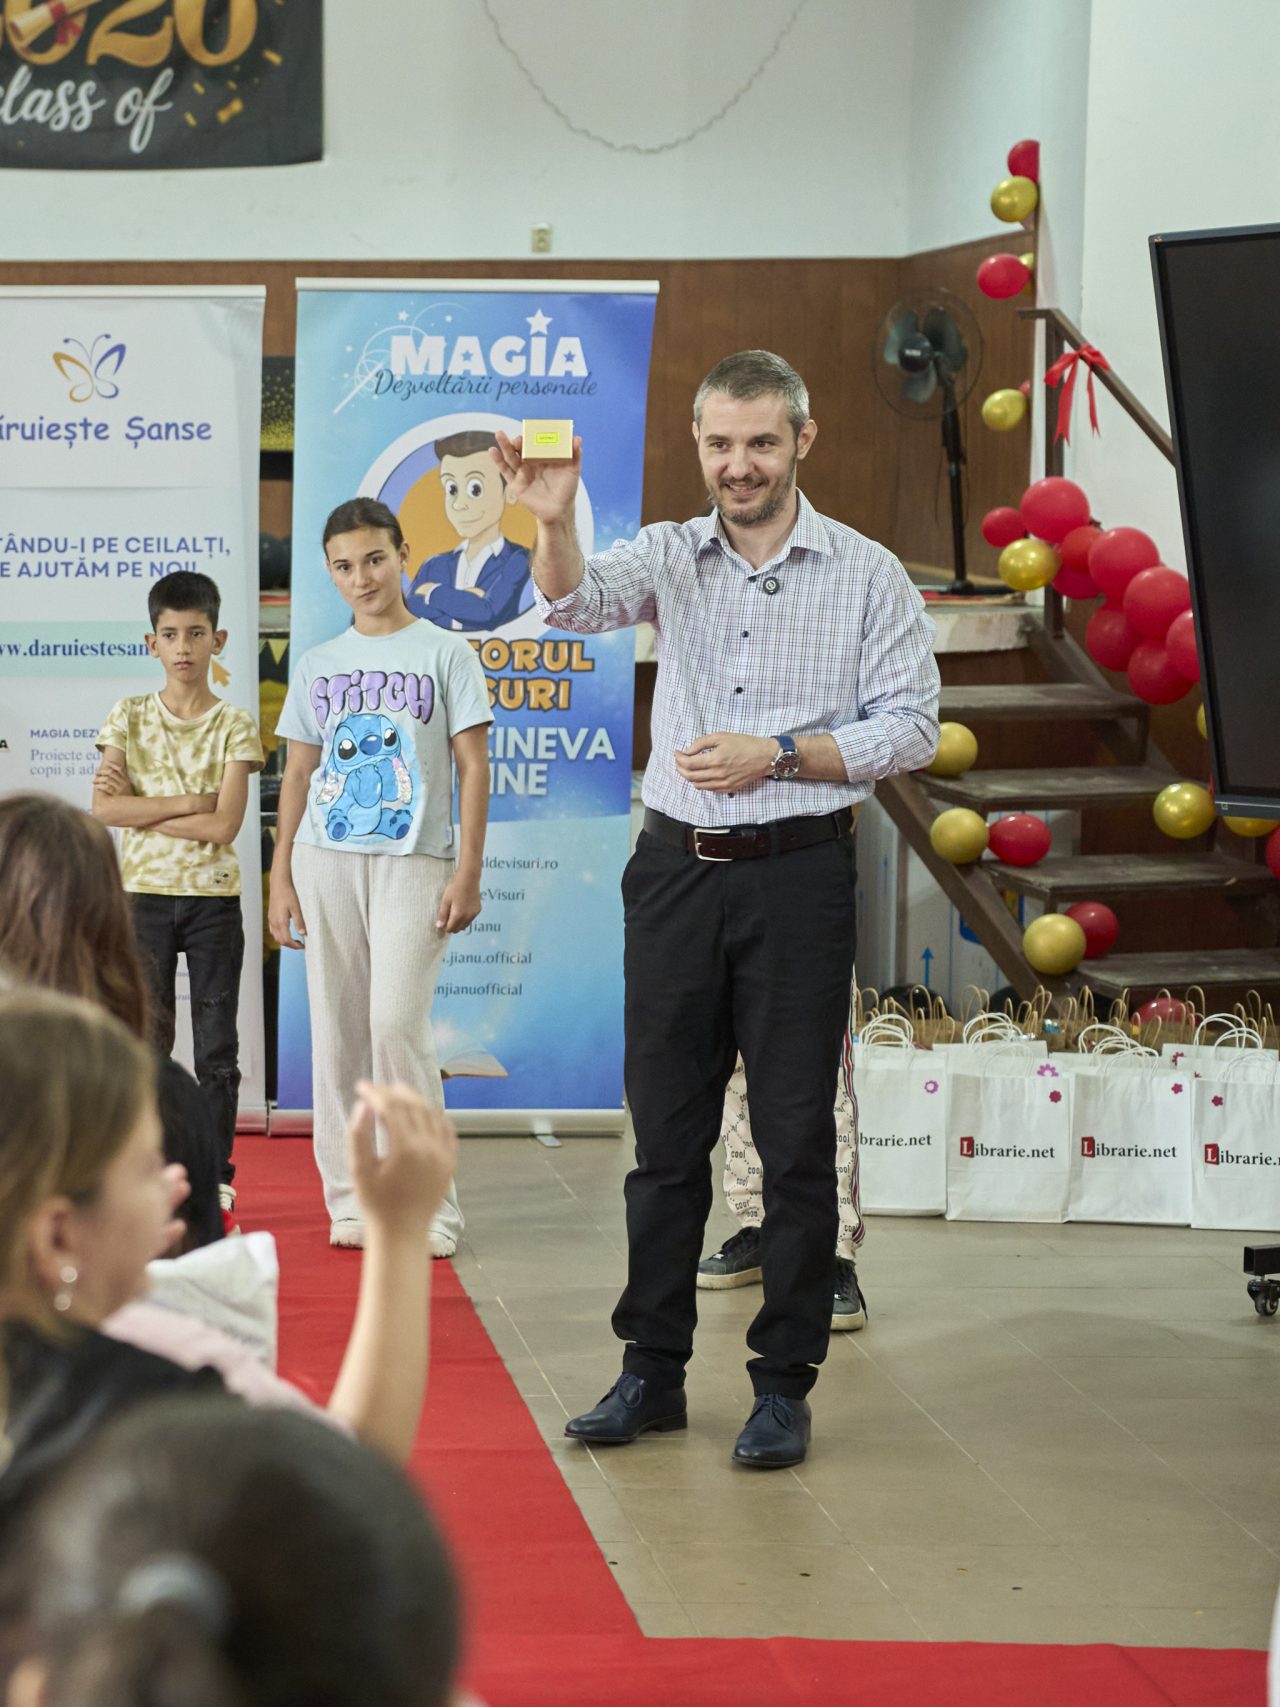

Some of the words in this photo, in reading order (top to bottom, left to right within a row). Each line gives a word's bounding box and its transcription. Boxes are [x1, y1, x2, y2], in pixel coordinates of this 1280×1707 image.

[114, 67, 174, 153] of
[391, 334, 589, 377] MAGIA
[375, 368, 493, 401] Dezvoltării
[496, 371, 598, 401] personale
[124, 416, 212, 448] Șanse
[93, 537, 118, 554] PE
[125, 537, 231, 559] CEILALȚI,
[17, 558, 110, 578] AJUTĂM
[117, 562, 142, 578] PE
[30, 729, 70, 738] MAGIA
[73, 729, 99, 738] DEZ
[30, 749, 82, 761] Proiecte
[85, 749, 101, 761] ed
[30, 764, 62, 778] copii
[79, 763, 95, 776] ad
[490, 763, 548, 795] INE
[481, 856, 559, 870] ldevisuri.ro
[480, 888, 526, 901] eVisuri
[466, 921, 502, 935] Jianu
[443, 951, 532, 967] .jianu.official
[435, 982, 523, 998] njianuofficial
[859, 1132, 933, 1147] brarie.net
[960, 1136, 1055, 1158] Librarie.net
[1081, 1136, 1177, 1158] Librarie.net
[1204, 1143, 1280, 1166] Librarie.
